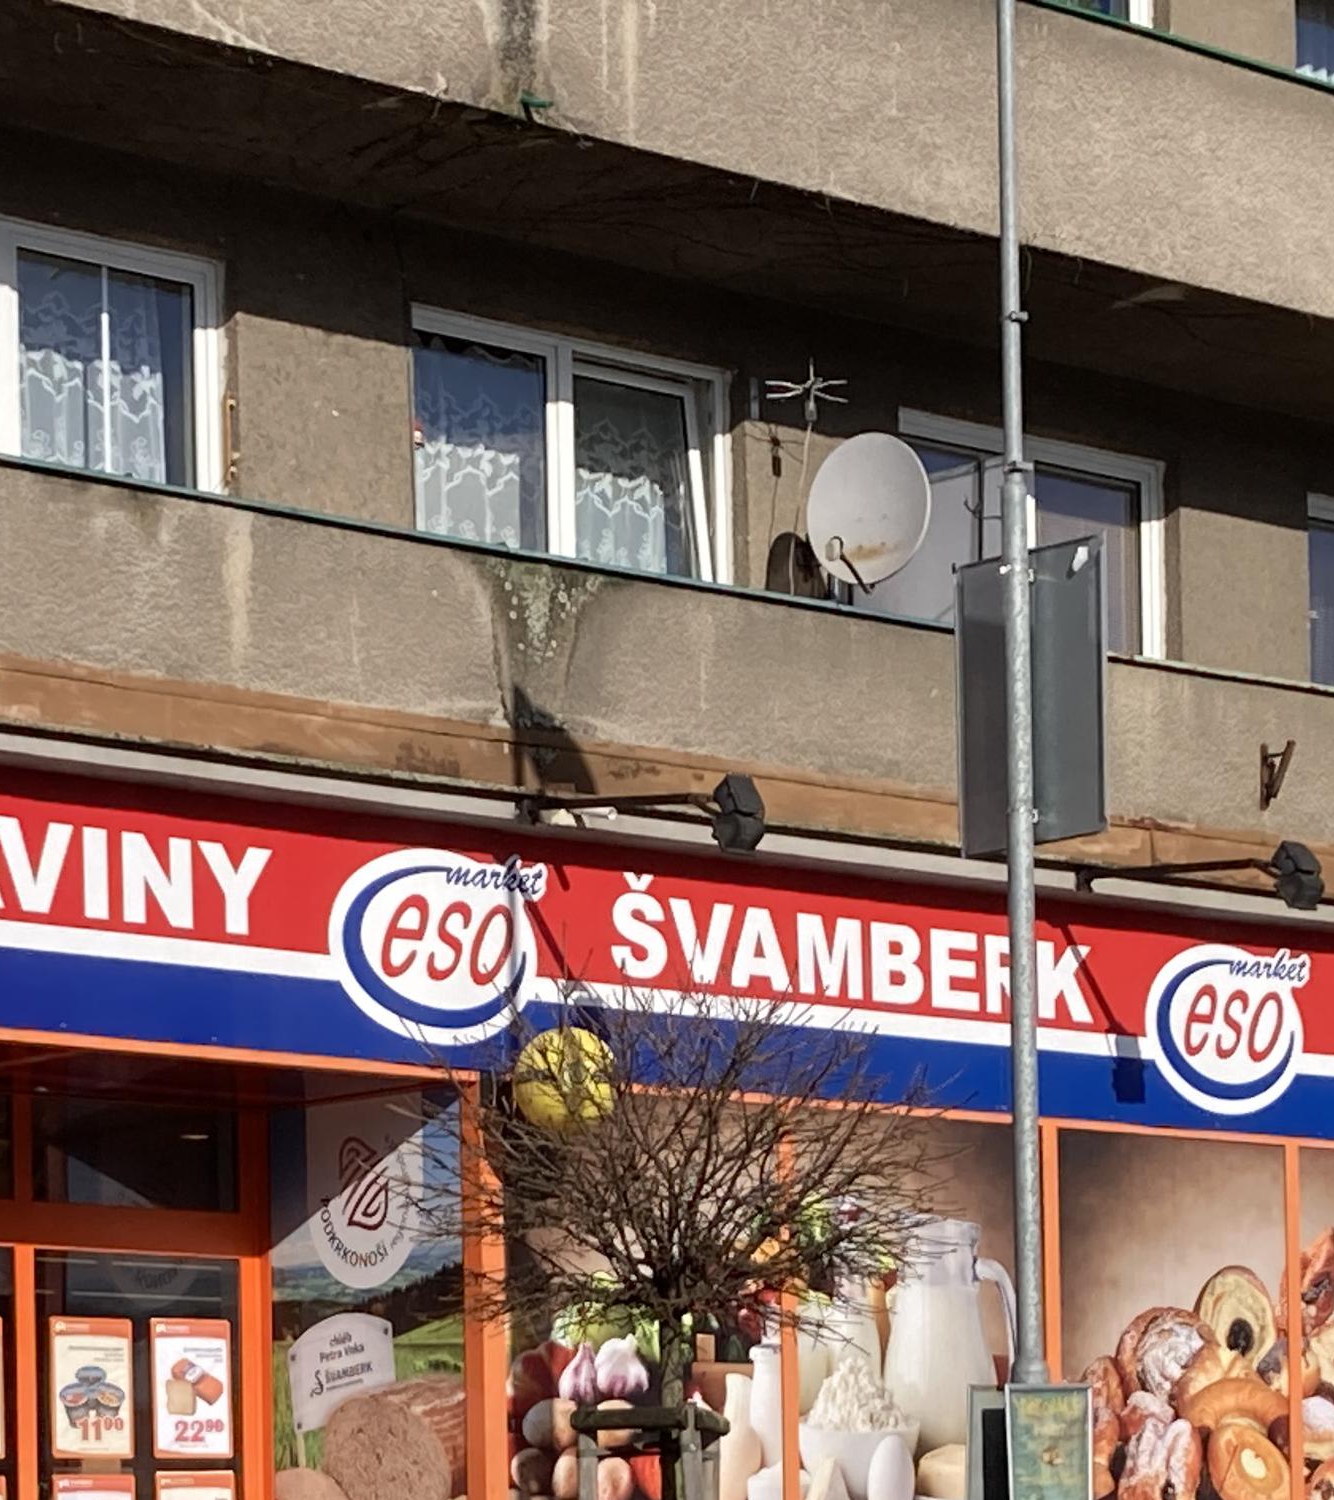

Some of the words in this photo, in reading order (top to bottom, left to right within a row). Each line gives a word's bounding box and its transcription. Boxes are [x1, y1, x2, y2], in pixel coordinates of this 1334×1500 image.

[446, 857, 543, 895] market
[381, 894, 514, 986] eso
[1229, 951, 1306, 981] market
[1184, 984, 1283, 1062] eso
